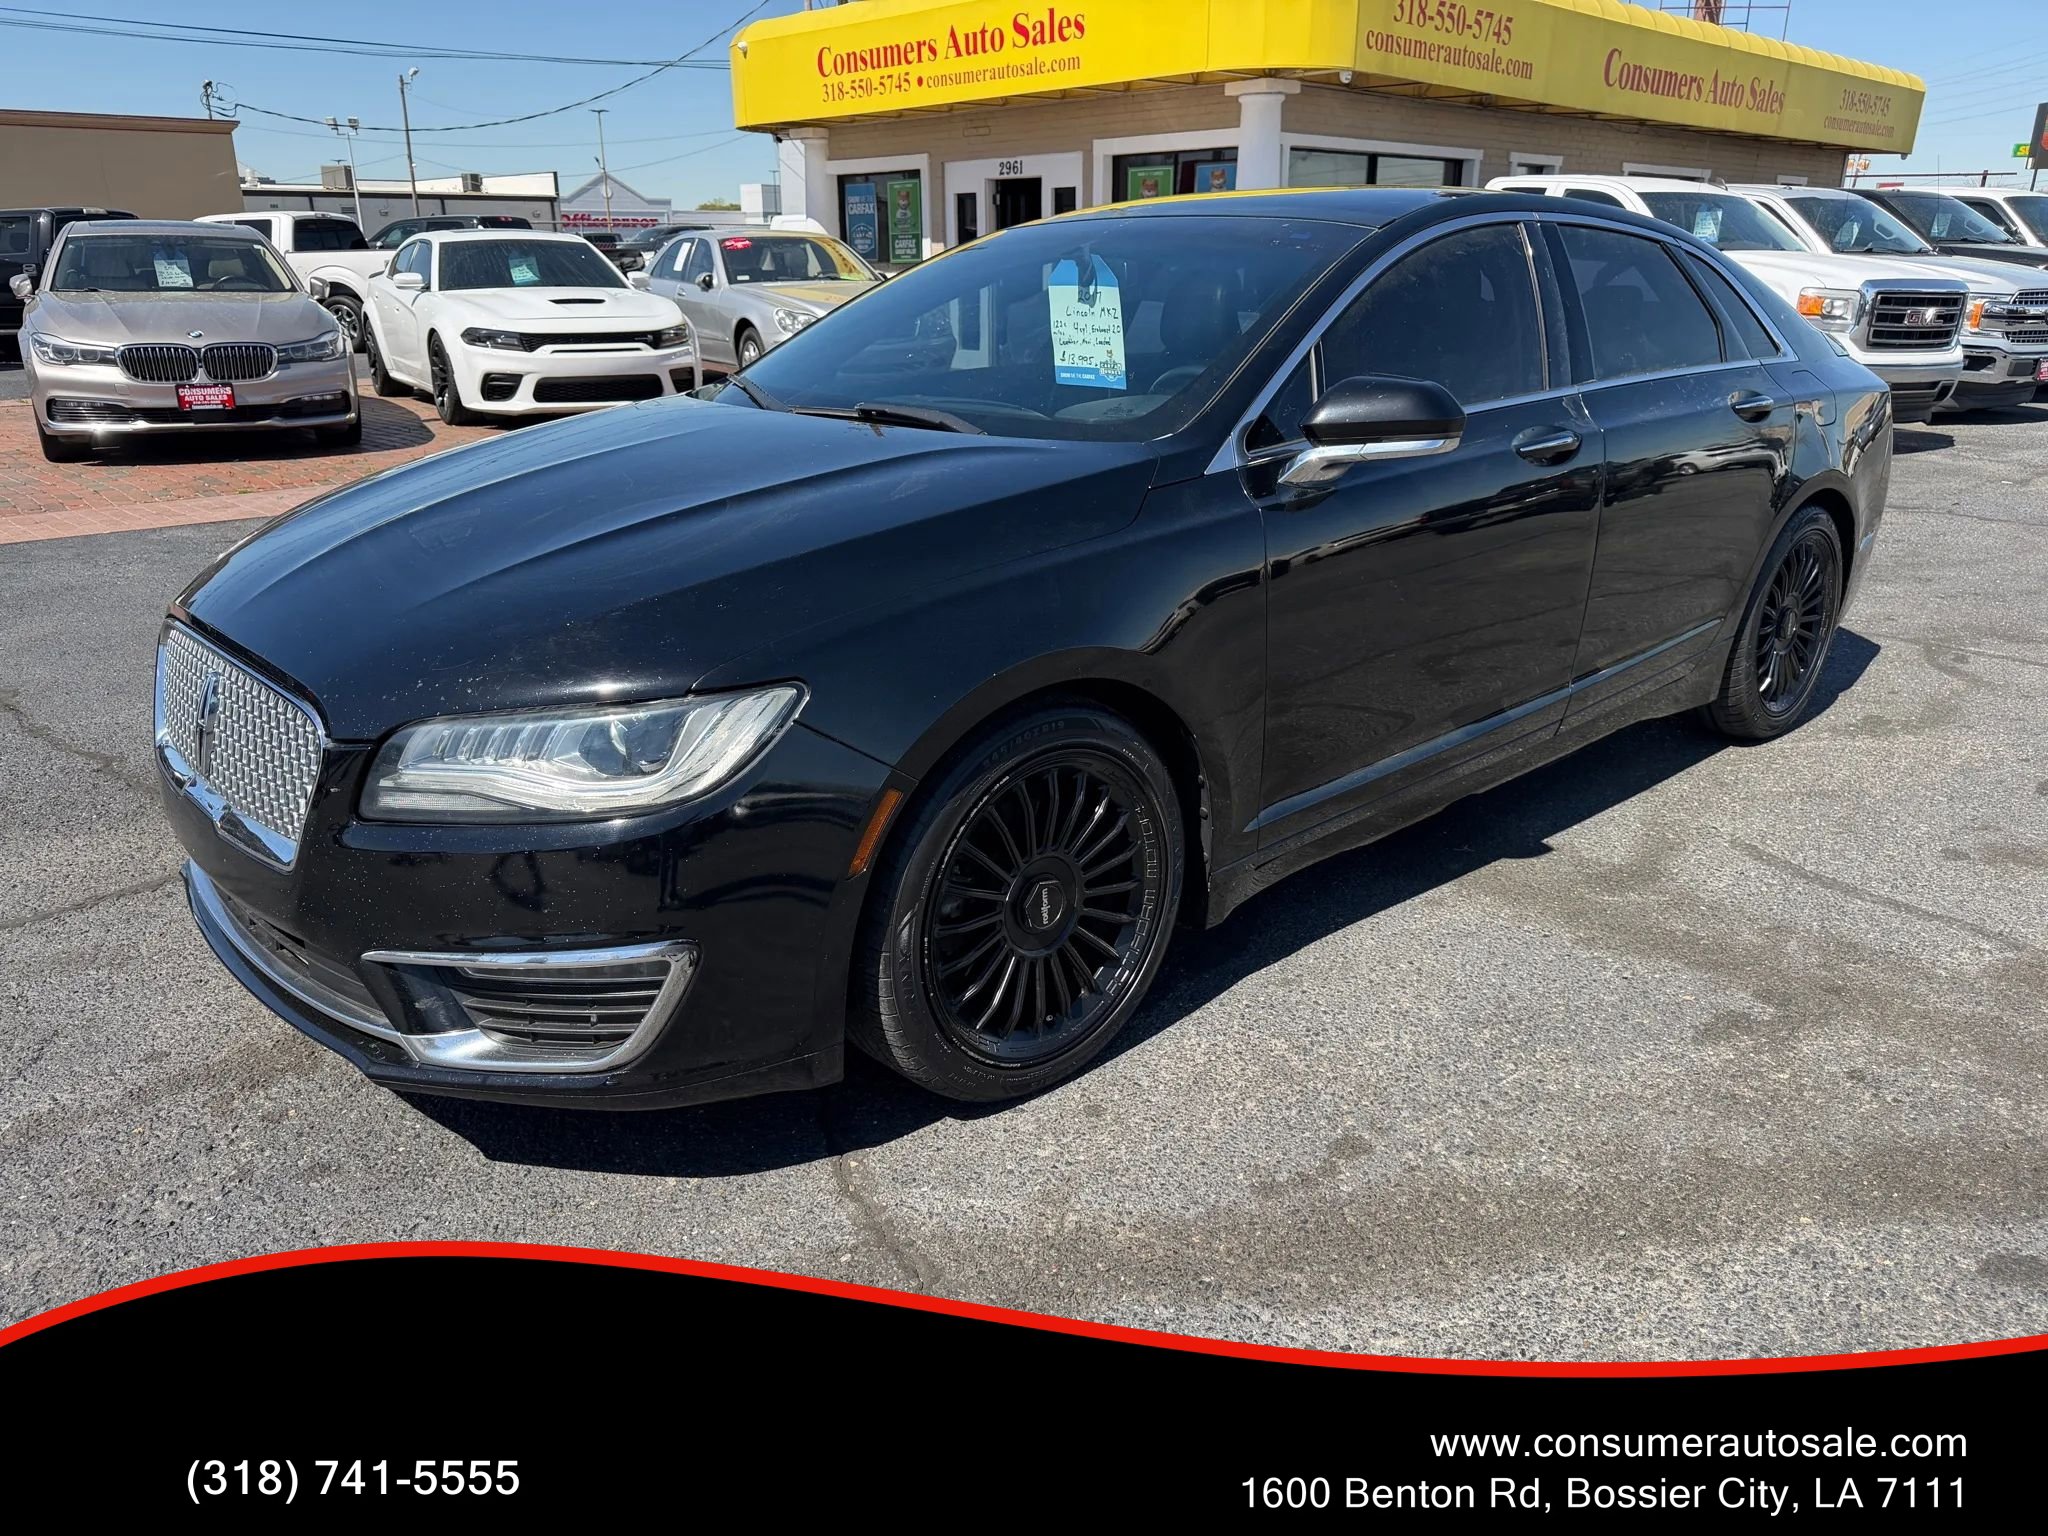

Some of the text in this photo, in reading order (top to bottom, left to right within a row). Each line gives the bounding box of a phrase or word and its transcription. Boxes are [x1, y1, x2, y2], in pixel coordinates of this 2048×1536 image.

[817, 8, 1086, 78] Consumers Auto Sales
[1393, 0, 1514, 46] 318-550-5745
[1366, 29, 1533, 80] consumerautosale.com
[822, 55, 1081, 103] 318-550-5745 consumerautosale.com
[1603, 47, 1786, 114] Consumers Auto Sales
[1823, 88, 1895, 139] 318-550-5745 consumerautosale.com
[999, 160, 1023, 176] 2961
[848, 203, 875, 215] CARFAX
[1066, 305, 1119, 319] Lincoln MKZ
[1904, 308, 1945, 326] GMC
[178, 387, 232, 396] CONSUMERS
[1041, 887, 1049, 926] rotiform
